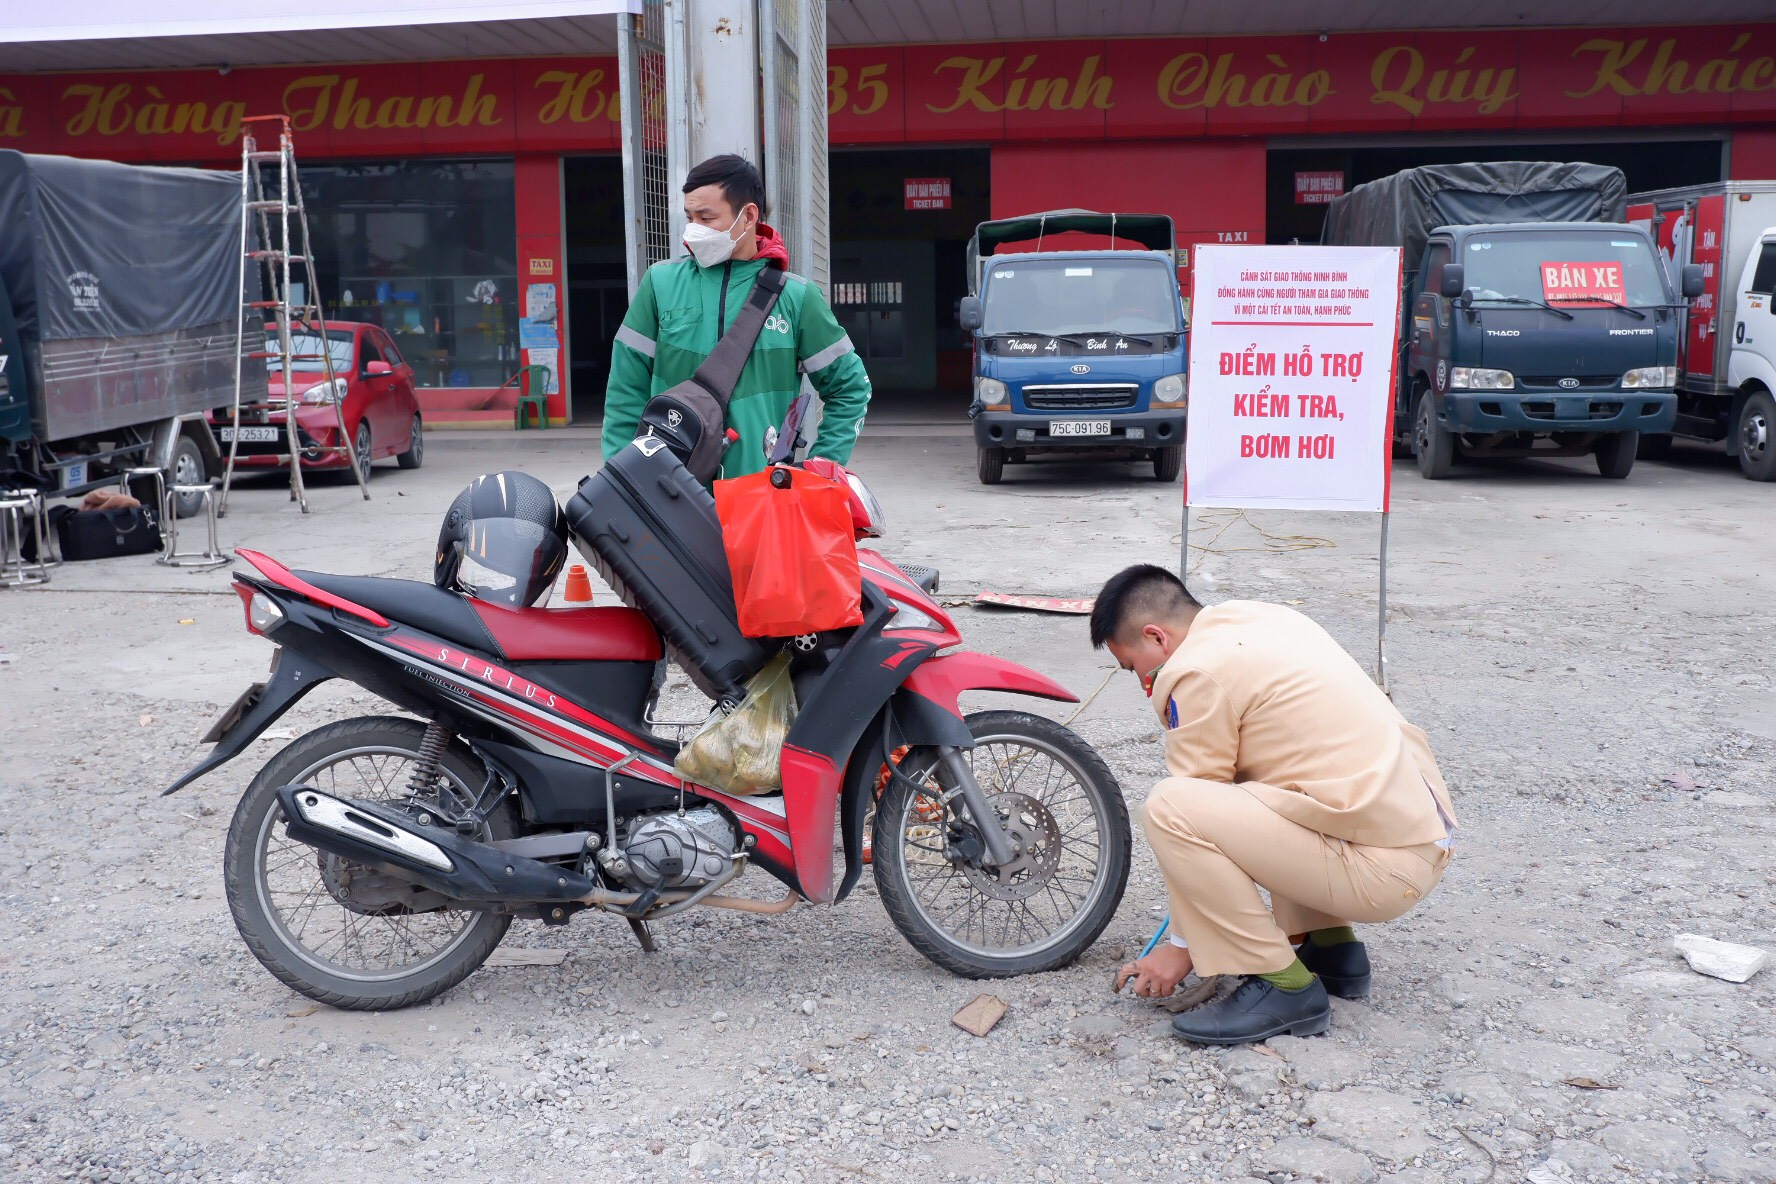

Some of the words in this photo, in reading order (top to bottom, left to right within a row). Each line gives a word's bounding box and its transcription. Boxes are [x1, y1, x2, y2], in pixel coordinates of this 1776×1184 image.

[926, 53, 1115, 113] Kính
[1157, 52, 1338, 110] Chào
[62, 83, 247, 146] Hàng
[282, 73, 503, 131] Thanh
[913, 200, 931, 208] TICKET
[932, 200, 943, 208] BAR
[1304, 193, 1322, 203] TICKET
[1218, 232, 1247, 242] TAXI
[531, 260, 552, 268] TAXI
[1240, 269, 1258, 281] CẢNH
[1260, 270, 1273, 281] SÁT
[1274, 272, 1289, 281] GIAO
[1291, 270, 1312, 282] THÔNG
[1314, 272, 1330, 282] NINH
[1332, 270, 1347, 282] BÌNH
[1545, 263, 1587, 288] BÁN
[1592, 267, 1619, 288] XE
[1238, 286, 1255, 298] HÀNH
[1257, 286, 1275, 298] CÙNG
[1276, 286, 1297, 299] NGƯỜI
[1298, 289, 1316, 298] THAM
[1318, 289, 1329, 298] GIA
[1331, 289, 1346, 299] GIAO
[1348, 287, 1369, 299] THÔNG
[1242, 303, 1256, 316] MỘT
[1257, 303, 1269, 315] CÁI
[1270, 302, 1282, 315] TẾT
[1283, 305, 1292, 315] AN
[1314, 305, 1332, 317] HẠNH
[1334, 303, 1351, 316] PHÚC
[1609, 328, 1654, 336] FRONTIER
[1007, 339, 1037, 353] Thượng
[1115, 338, 1128, 349] An
[1219, 343, 1276, 376] ĐIỂM
[1283, 344, 1313, 377] HỖ
[1321, 352, 1363, 382] TRỢ
[1234, 384, 1290, 417] KIỂM
[1298, 395, 1344, 421] TRA,
[1052, 422, 1109, 435] 75C-091.96
[1241, 433, 1291, 458] BƠM
[1298, 434, 1335, 459] HƠI
[404, 665, 423, 677] FUEL
[423, 674, 471, 697] INJECTION
[437, 648, 557, 707] SIRIUS
